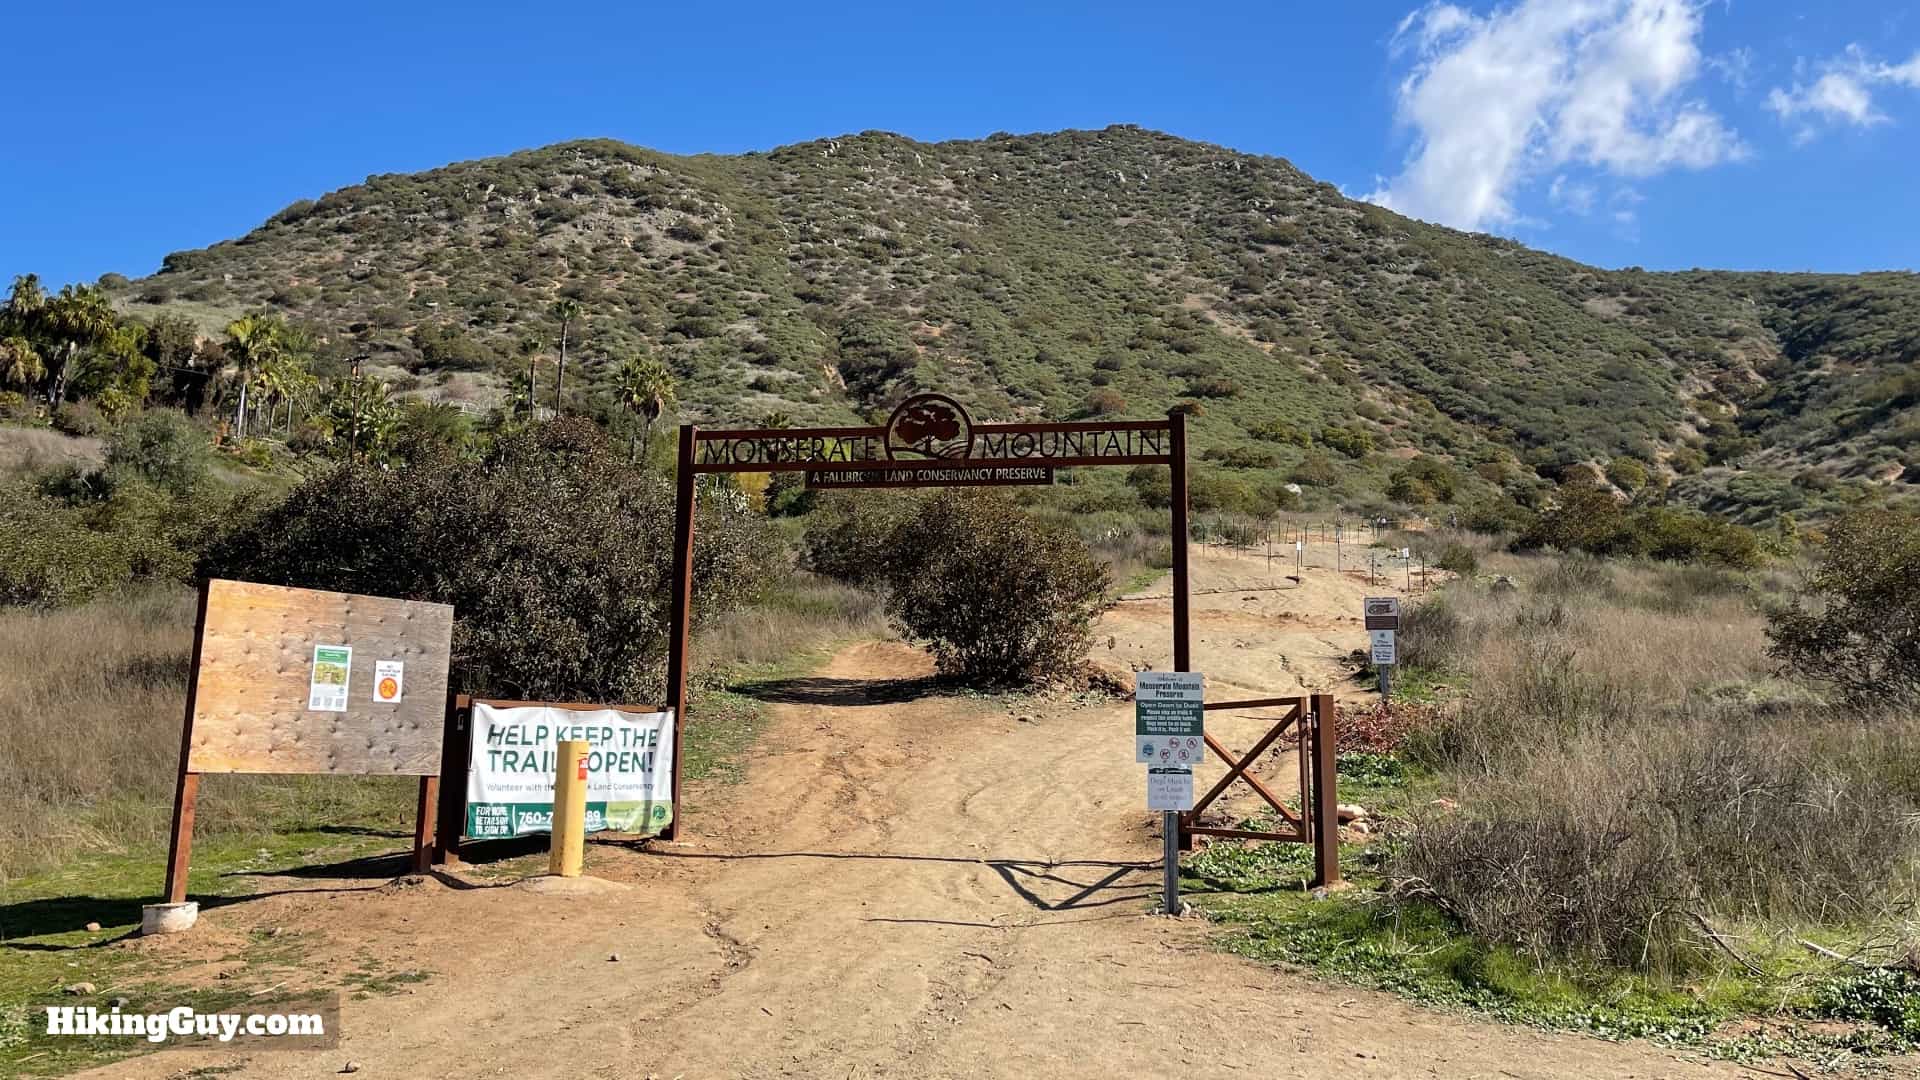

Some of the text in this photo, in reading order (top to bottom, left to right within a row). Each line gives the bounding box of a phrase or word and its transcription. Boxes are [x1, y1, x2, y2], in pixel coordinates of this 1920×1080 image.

[703, 429, 1161, 464] MONSERATE MOUNTAIN
[812, 471, 821, 483] A
[885, 470, 914, 482] LAND
[917, 468, 992, 481] CONSERVANCY
[995, 467, 1046, 480] PRESERVE
[487, 724, 549, 746] HELP
[619, 727, 659, 747] THE
[487, 749, 556, 773] TRAIL
[588, 751, 654, 773] OPEN!
[487, 783, 523, 792] Volunteer
[525, 783, 542, 792] with
[594, 783, 612, 791] Land
[613, 783, 655, 792] Conservancy
[476, 806, 490, 816] FOR
